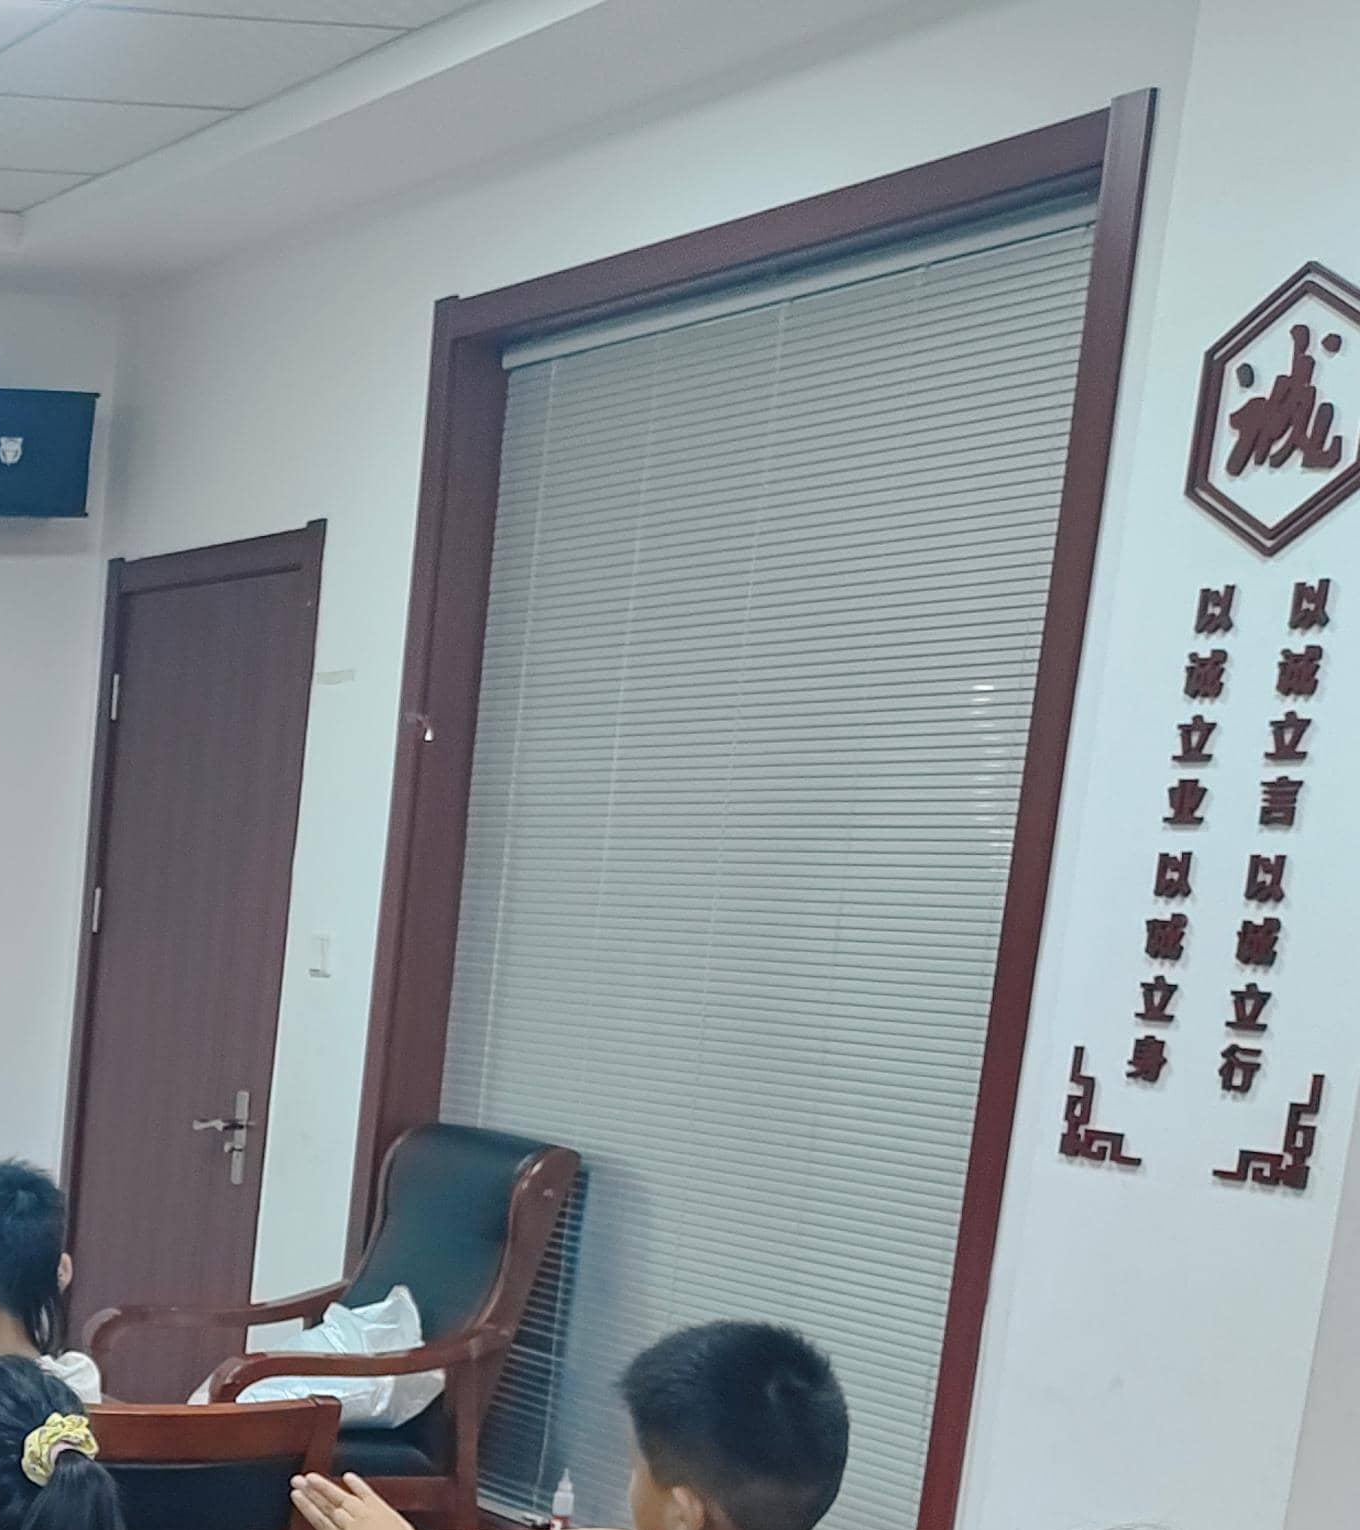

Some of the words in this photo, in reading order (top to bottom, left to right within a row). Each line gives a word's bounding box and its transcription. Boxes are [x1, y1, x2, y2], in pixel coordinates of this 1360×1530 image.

[1162, 583, 1237, 827] 以诚立业
[1258, 577, 1333, 829] 以诚立言
[1125, 850, 1193, 1086] 以诚立身
[1217, 853, 1288, 1094] 以诚立行
